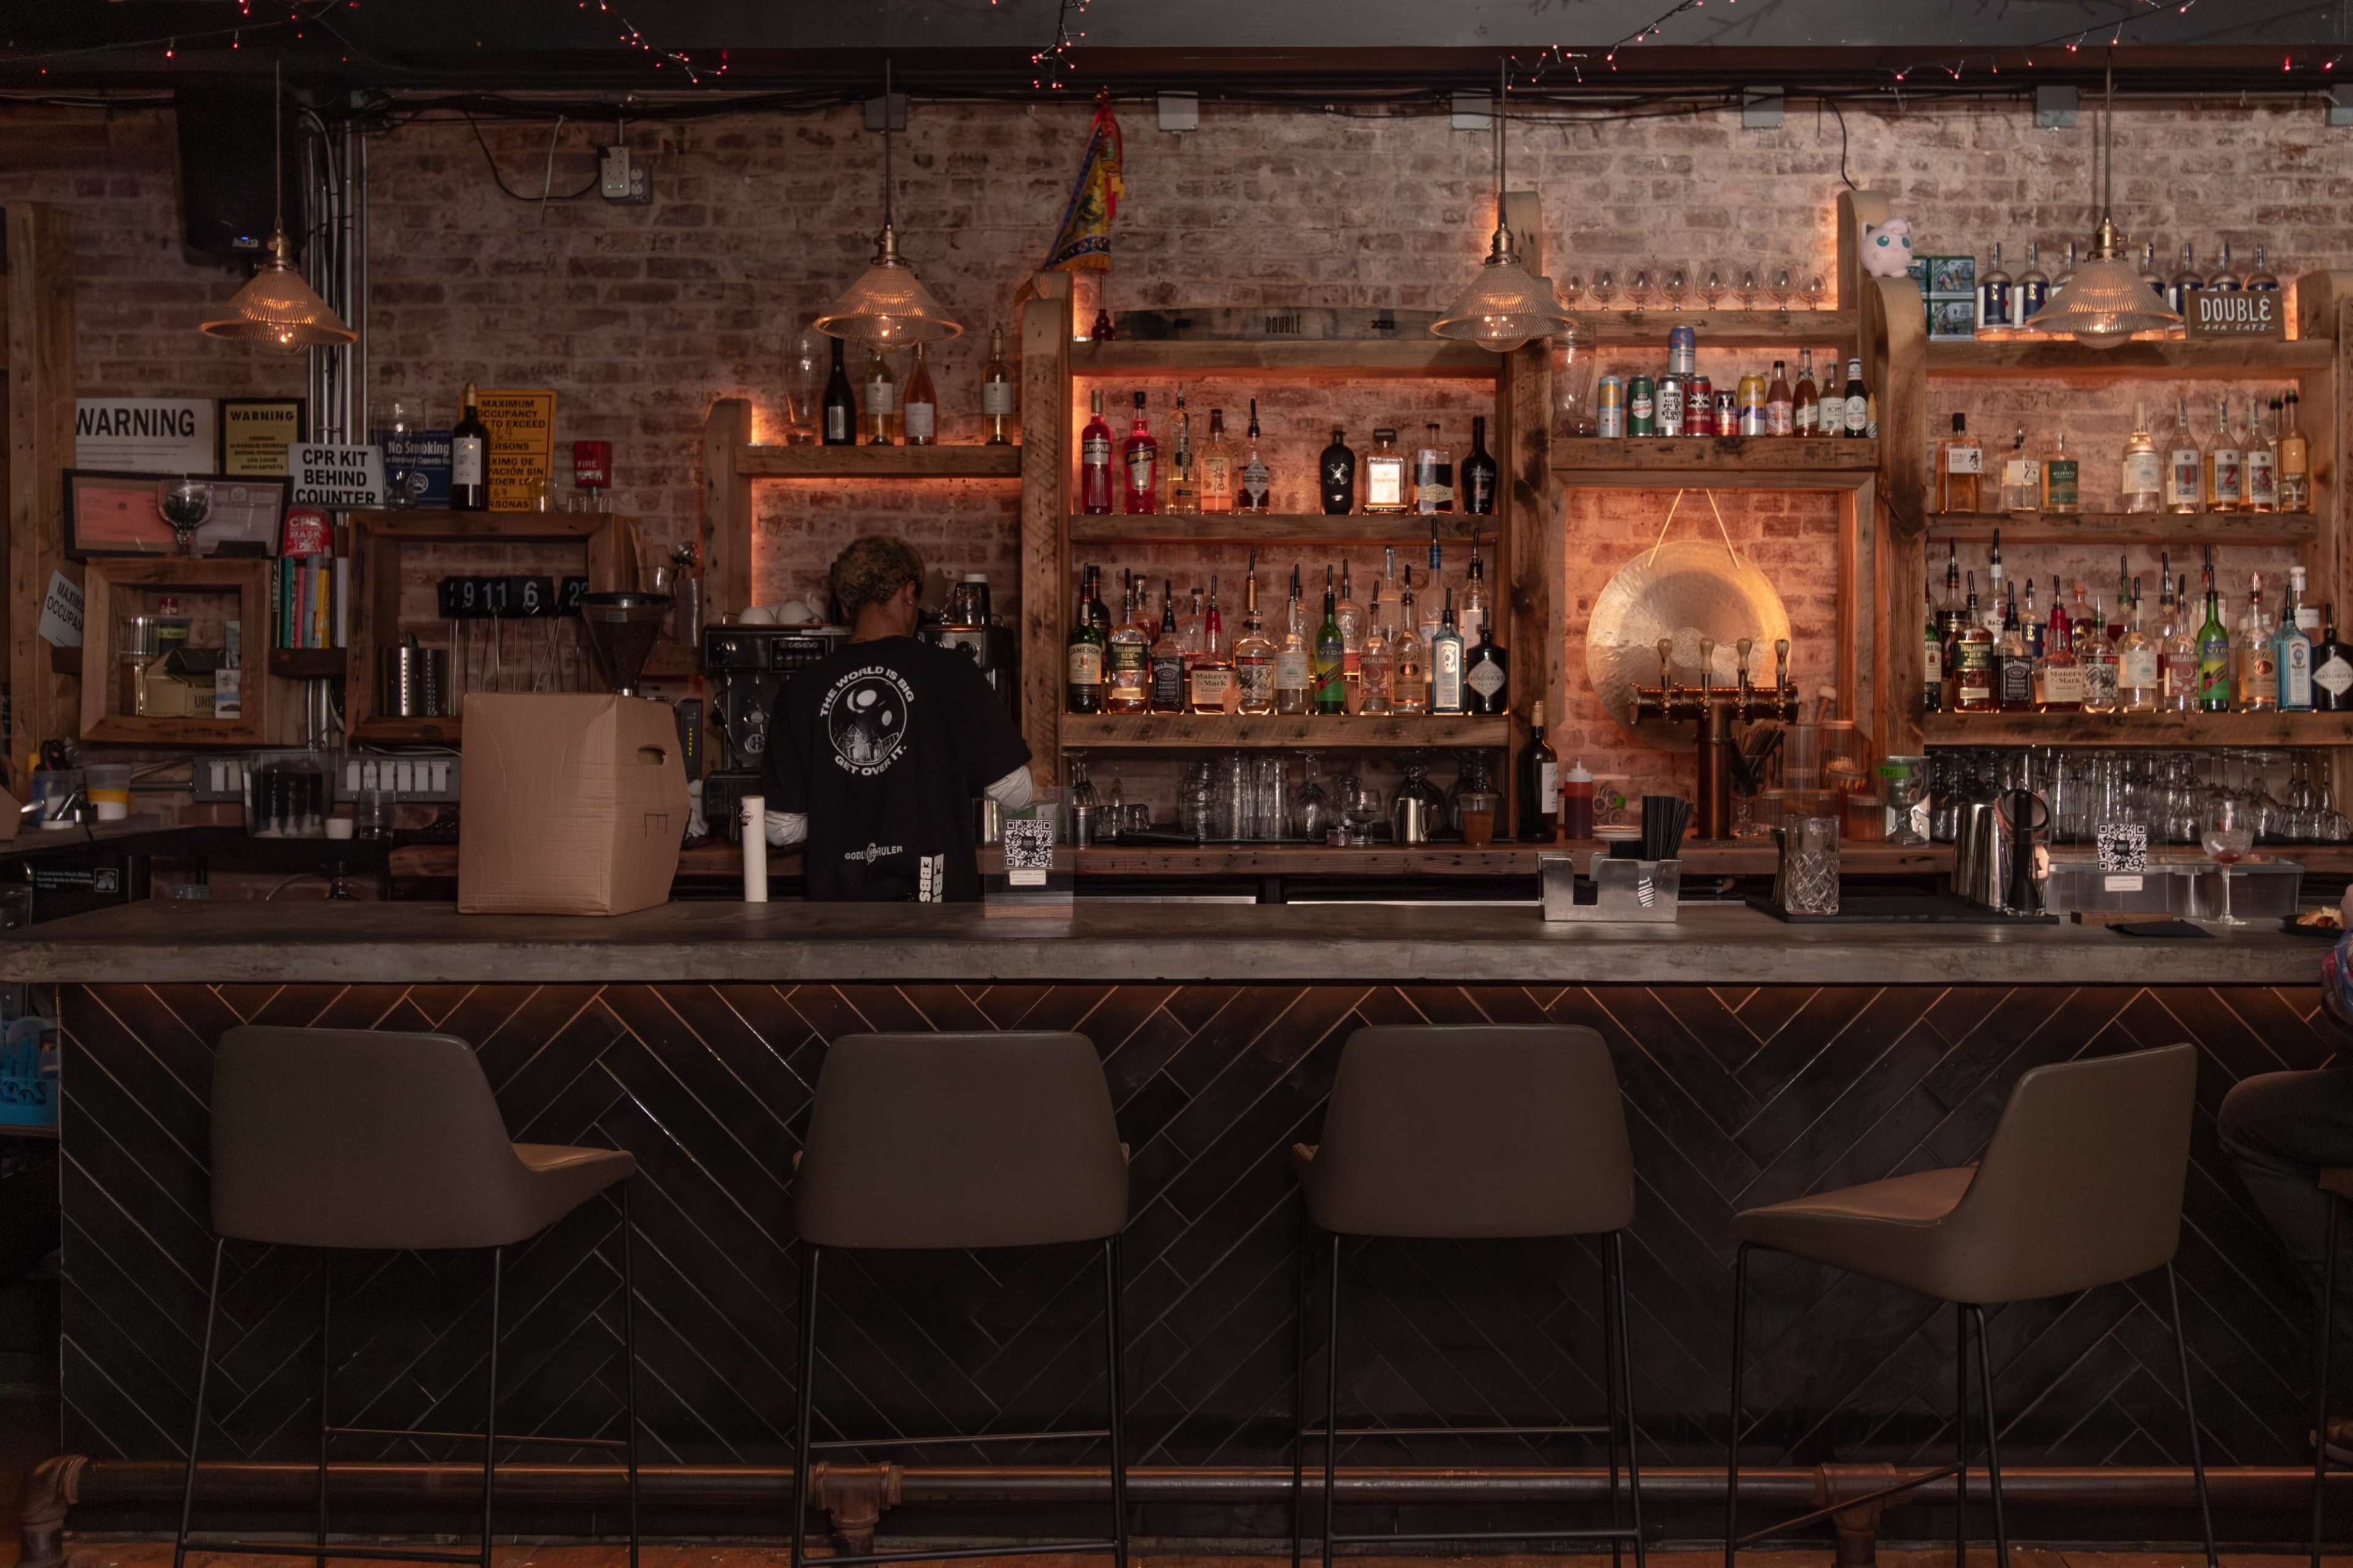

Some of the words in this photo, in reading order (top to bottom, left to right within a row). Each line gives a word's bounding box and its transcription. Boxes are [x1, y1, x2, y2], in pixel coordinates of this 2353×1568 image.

[76, 408, 195, 437] WARNING
[230, 411, 294, 422] WARNING
[506, 419, 546, 428] EXCEED
[388, 441, 403, 454] No
[405, 441, 450, 456] Smoking
[301, 450, 335, 466] CPR
[340, 451, 368, 466] KIT
[305, 469, 366, 486] BEHIND
[490, 466, 524, 475] ACIÓN
[2185, 466, 2191, 485] 1
[2225, 466, 2237, 485] 2
[2259, 468, 2271, 487] 3
[296, 490, 375, 505] COUNTER
[490, 500, 529, 509] RSONAS
[289, 530, 322, 539] MASK
[57, 580, 83, 612] MAXIM
[46, 596, 83, 632] OCCUPAN
[1069, 646, 1101, 656] JAMESON
[820, 688, 838, 717] THE
[835, 665, 884, 688] WORLD
[885, 668, 899, 681] IS
[896, 678, 915, 703] BIG
[835, 755, 859, 775] GET
[861, 757, 891, 776] OVER
